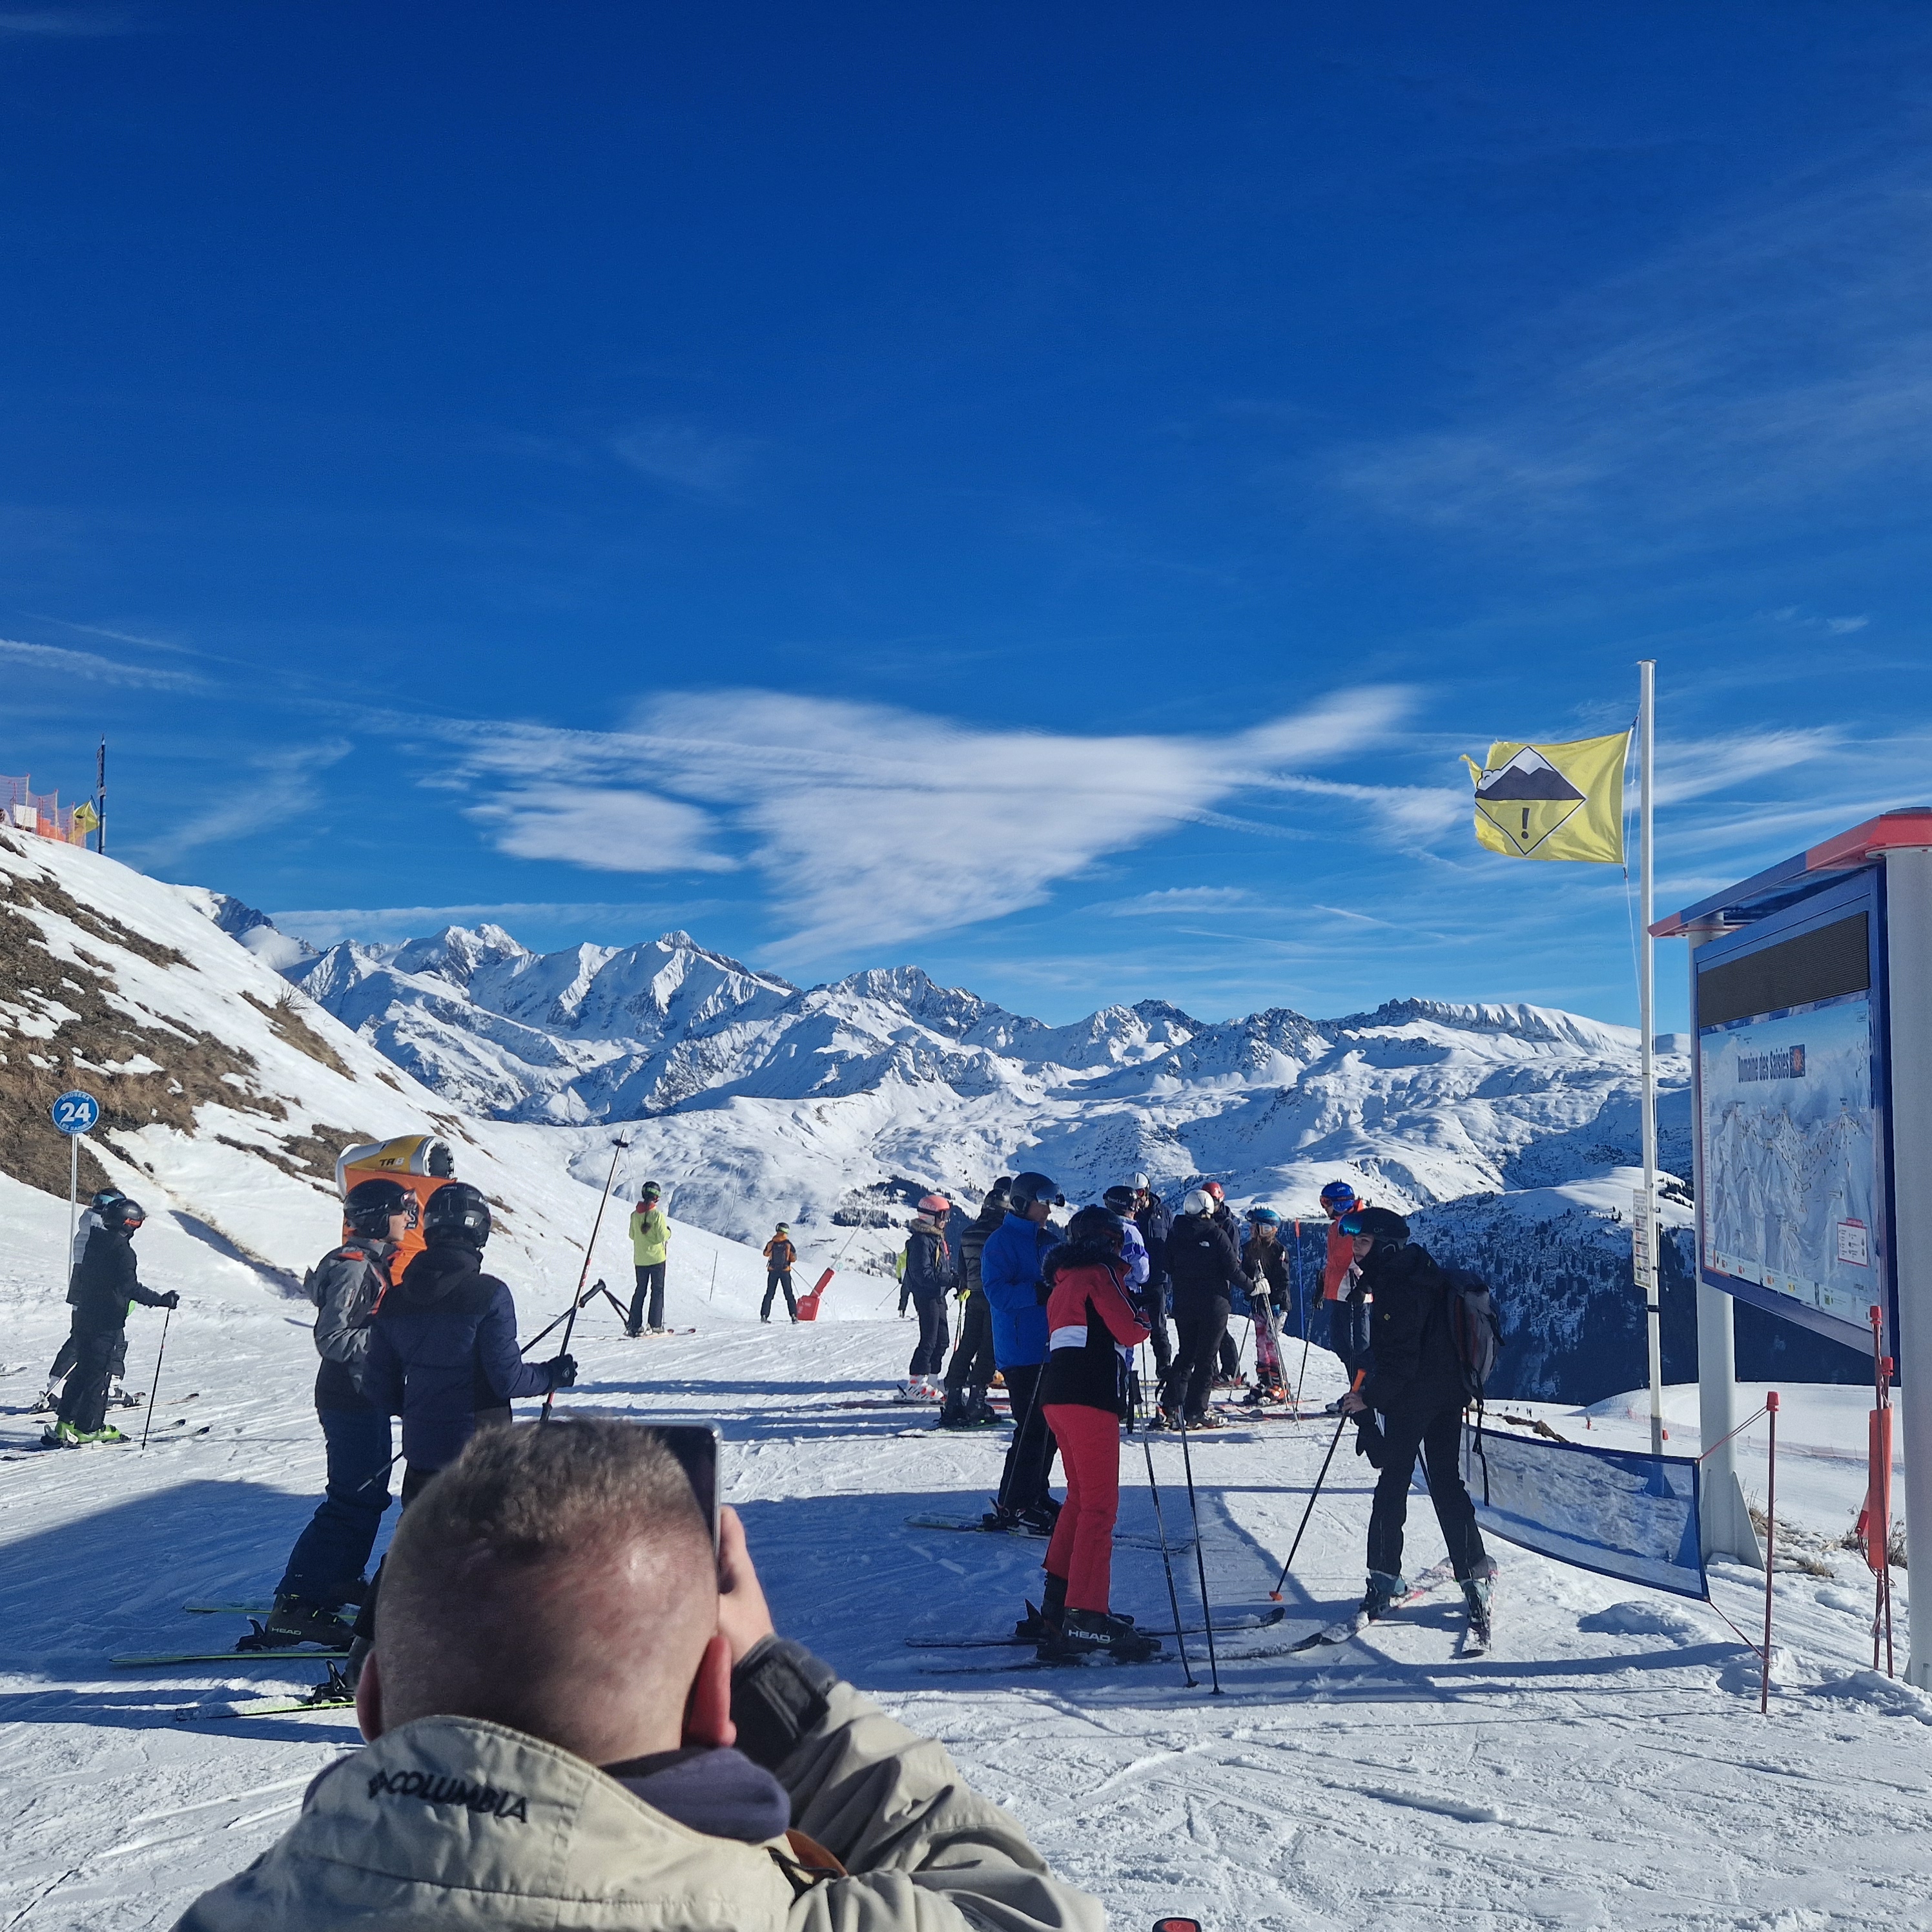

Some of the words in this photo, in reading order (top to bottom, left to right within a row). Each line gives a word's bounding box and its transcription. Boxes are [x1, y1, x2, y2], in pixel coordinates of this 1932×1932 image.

[1759, 1052, 1769, 1080] des
[1769, 1047, 1789, 1080] Saisies
[60, 1102, 91, 1122] 24
[1068, 1629, 1111, 1641] HEAD
[387, 1771, 527, 1824] COLUMBIA
